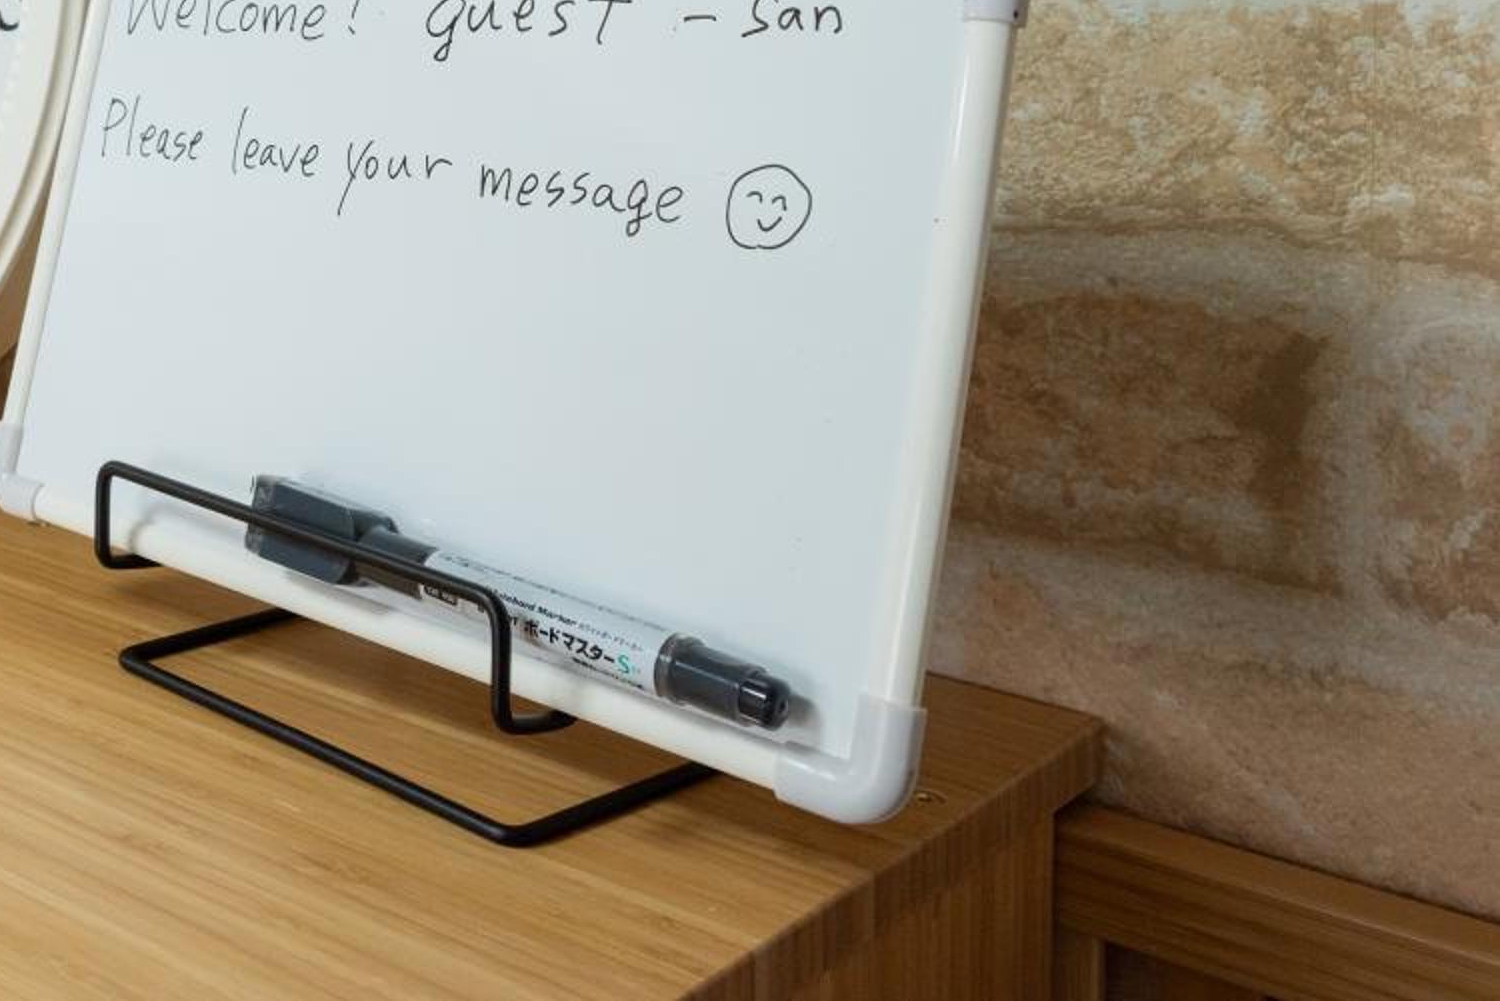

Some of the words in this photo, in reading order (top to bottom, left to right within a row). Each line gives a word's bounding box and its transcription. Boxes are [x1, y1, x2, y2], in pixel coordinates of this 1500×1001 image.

[101, 95, 203, 162] Please
[232, 107, 319, 177] leave
[337, 140, 452, 216] your
[480, 164, 684, 237] message
